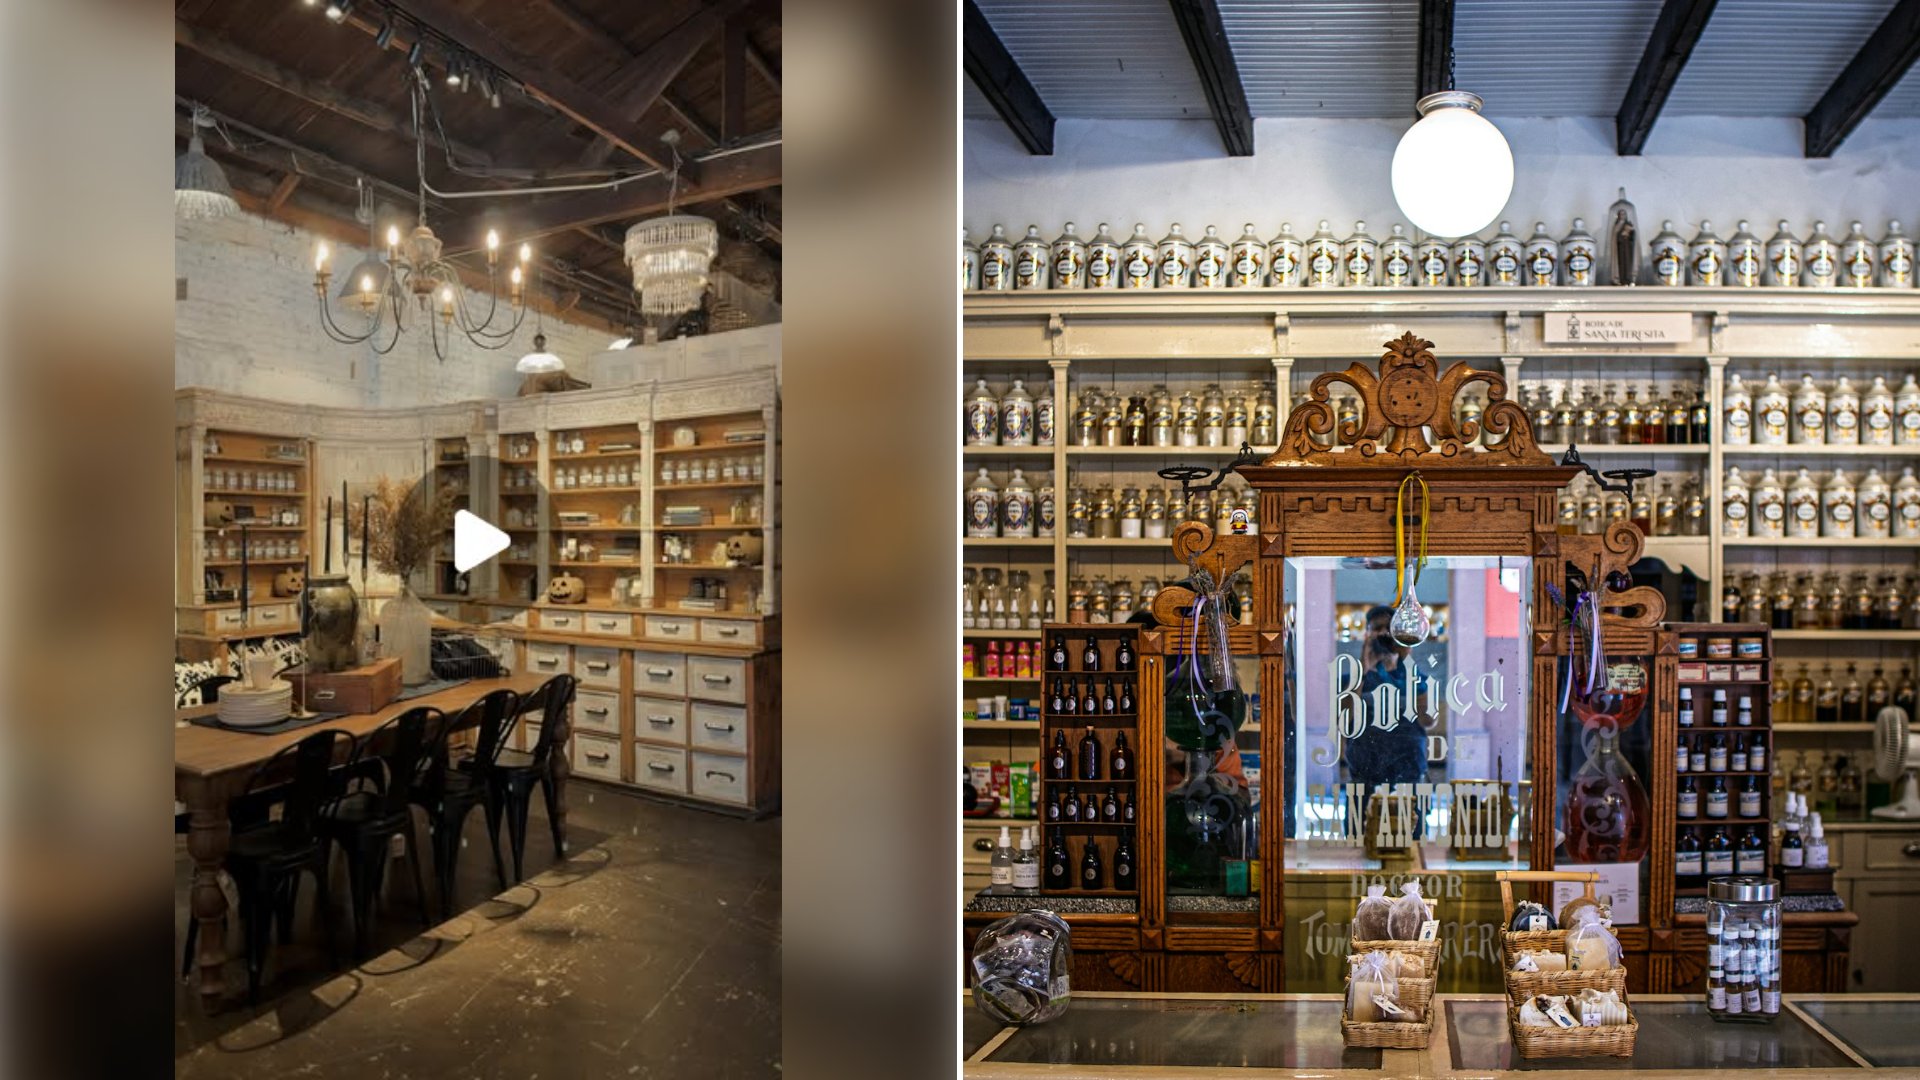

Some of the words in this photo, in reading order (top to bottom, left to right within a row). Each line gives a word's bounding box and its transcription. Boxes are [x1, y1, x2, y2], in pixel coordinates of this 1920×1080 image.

[1585, 329, 1617, 341] SANTA
[1620, 329, 1666, 341] TERESITA
[1311, 653, 1508, 767] Botica
[1427, 735, 1473, 761] DE
[1308, 783, 1365, 848] SAN
